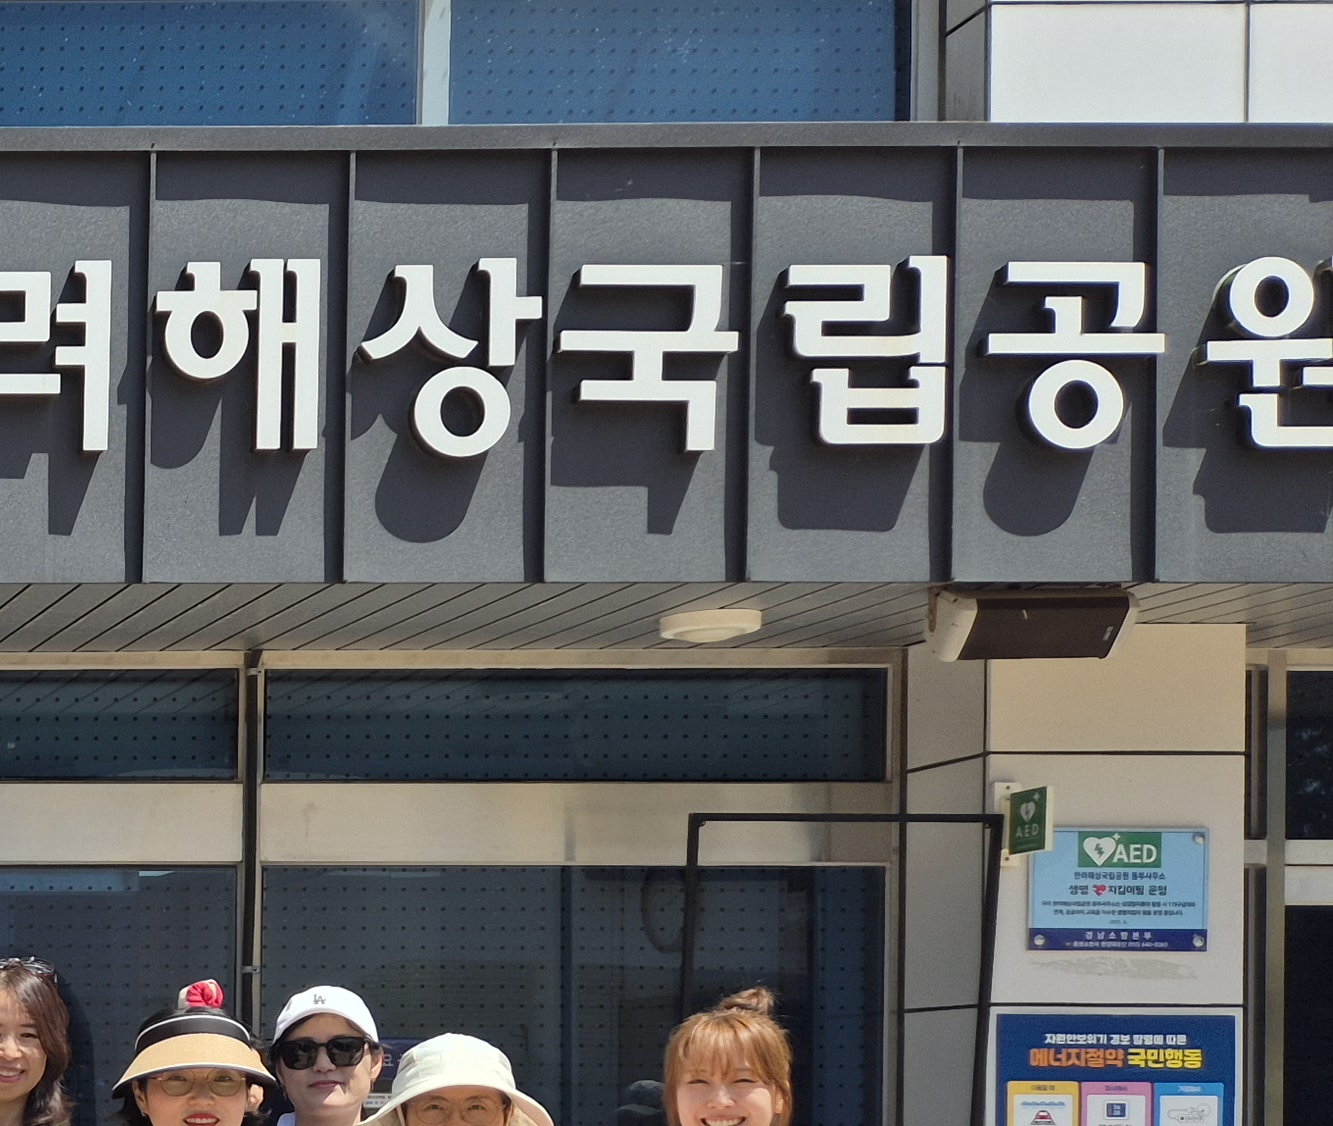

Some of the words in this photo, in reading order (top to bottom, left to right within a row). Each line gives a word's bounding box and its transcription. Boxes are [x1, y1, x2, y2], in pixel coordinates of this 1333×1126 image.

[1015, 823, 1039, 839] AED
[1112, 844, 1157, 863] AED
[313, 994, 326, 1005] LA
[1030, 1047, 1125, 1068] 에너지절약
[1127, 1047, 1202, 1069] 국민행동
